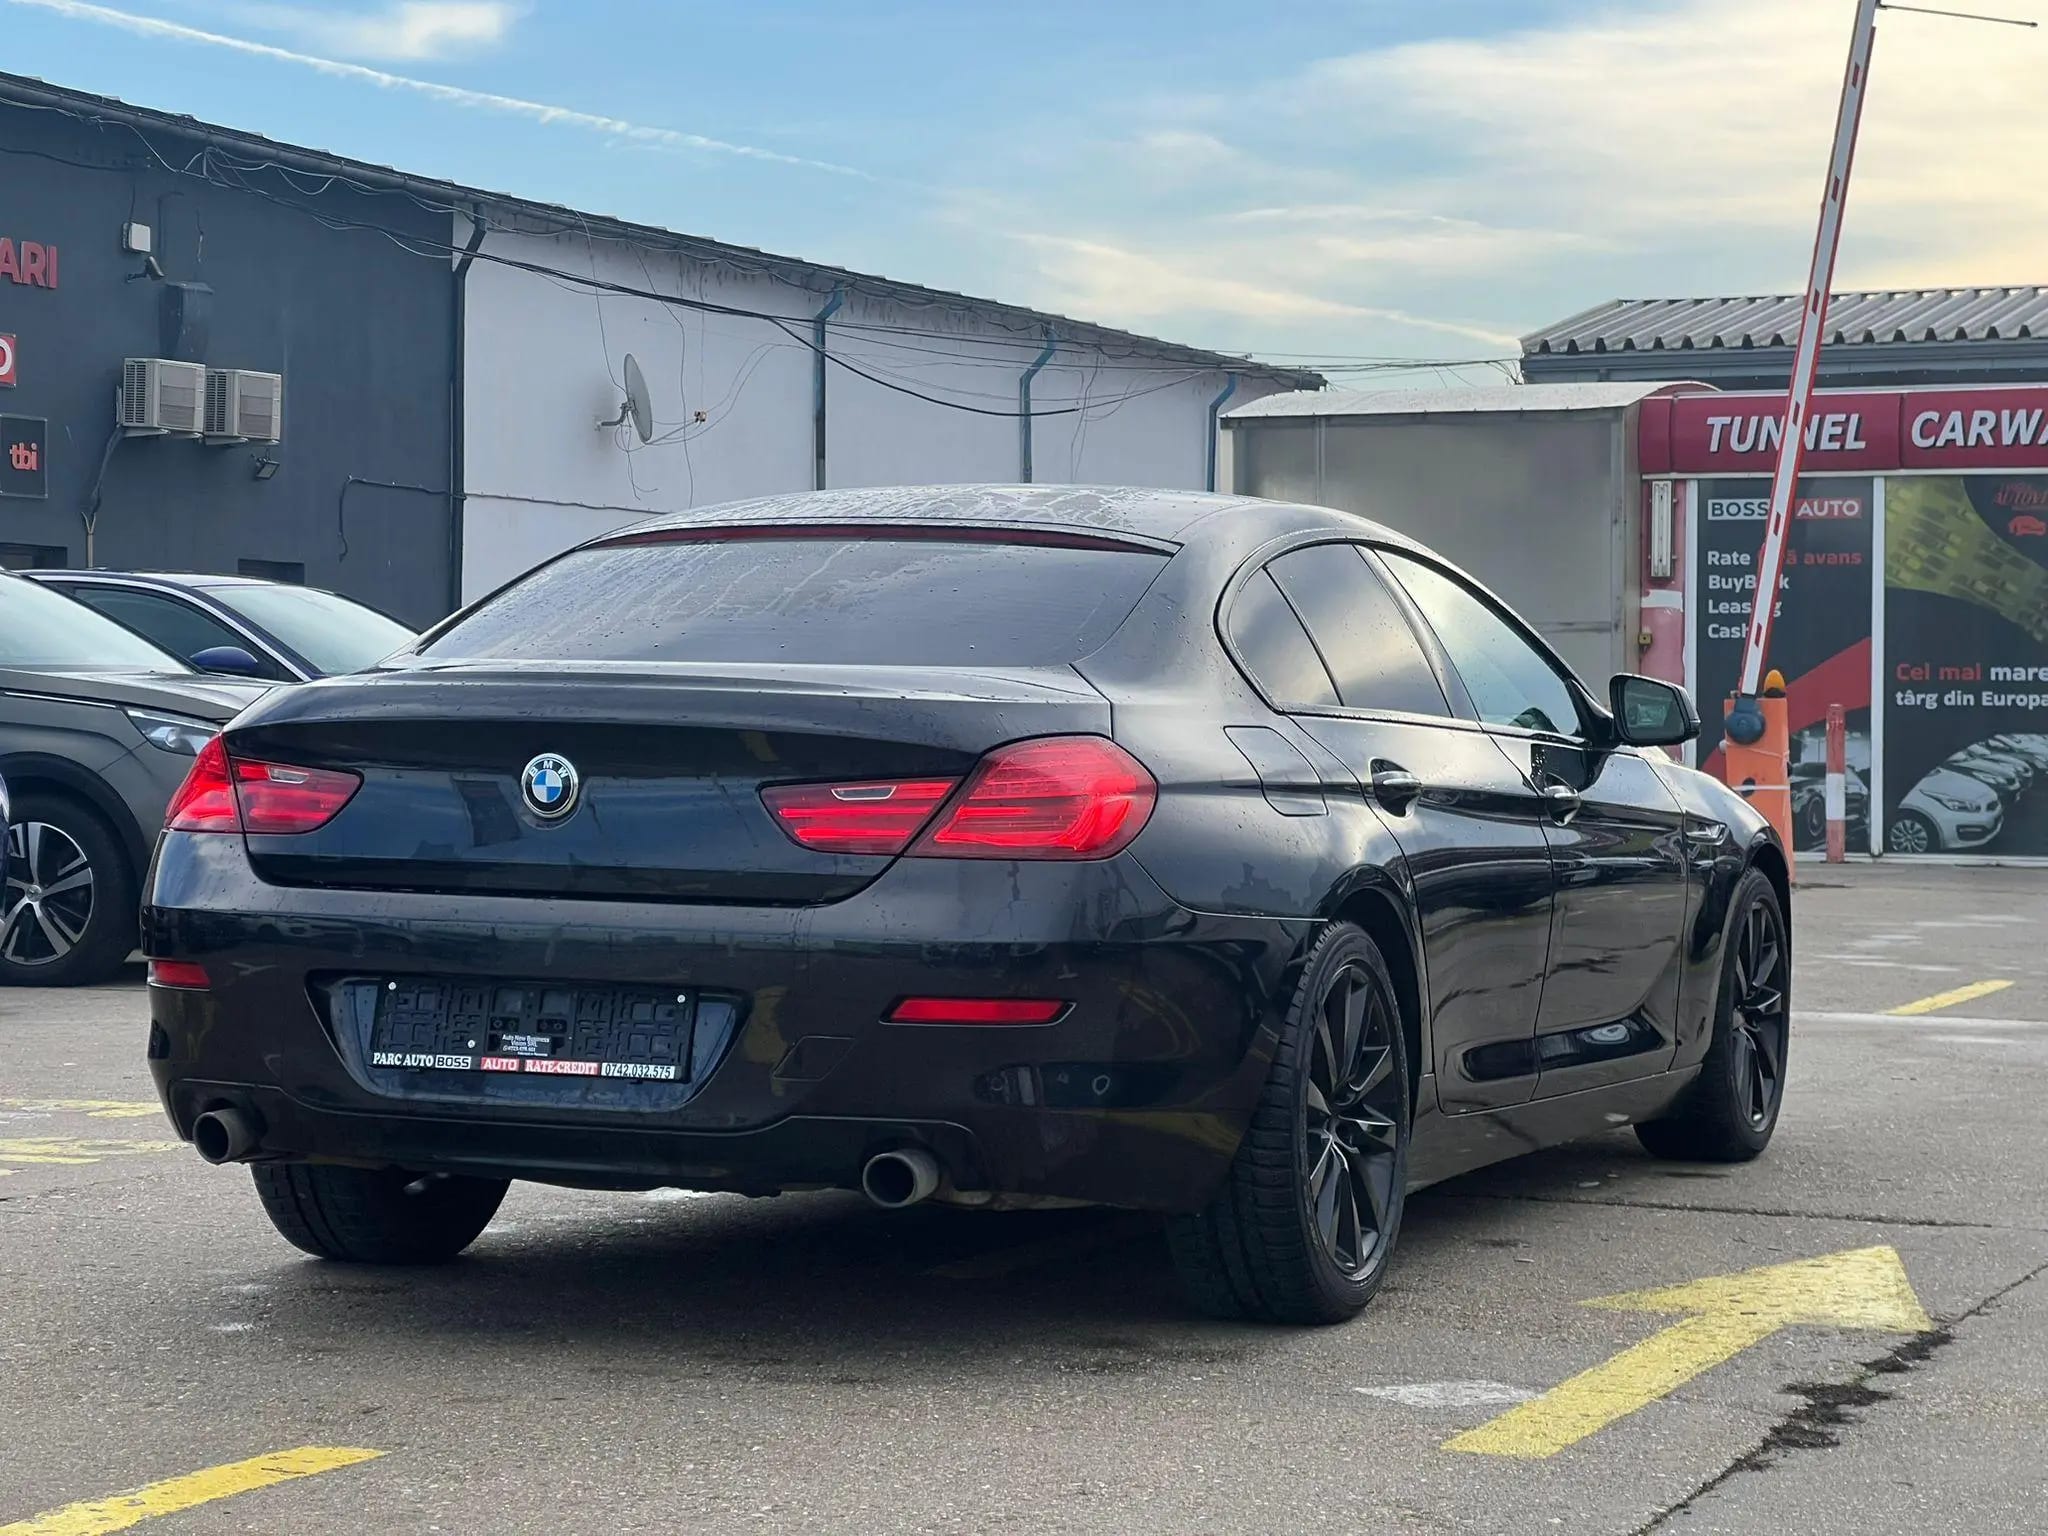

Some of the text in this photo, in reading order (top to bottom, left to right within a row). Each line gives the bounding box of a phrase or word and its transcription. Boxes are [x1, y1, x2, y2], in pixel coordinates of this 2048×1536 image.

[9, 442, 38, 471] tbi
[1711, 500, 1860, 517] BOSS AUTO
[1707, 551, 1750, 565] Rate
[1804, 552, 1862, 565] avans
[1708, 574, 1790, 593] BuyBk
[1708, 599, 1782, 617] Leasg
[1896, 662, 1931, 681] Cel
[1990, 666, 2048, 681] mare
[1895, 689, 1938, 709] târg
[1943, 690, 1975, 706] din
[528, 760, 569, 779] BMW
[372, 1052, 402, 1065] PARC
[402, 1053, 434, 1067] AUTO
[435, 1056, 470, 1068] BOSS
[482, 1058, 518, 1071] AUTO
